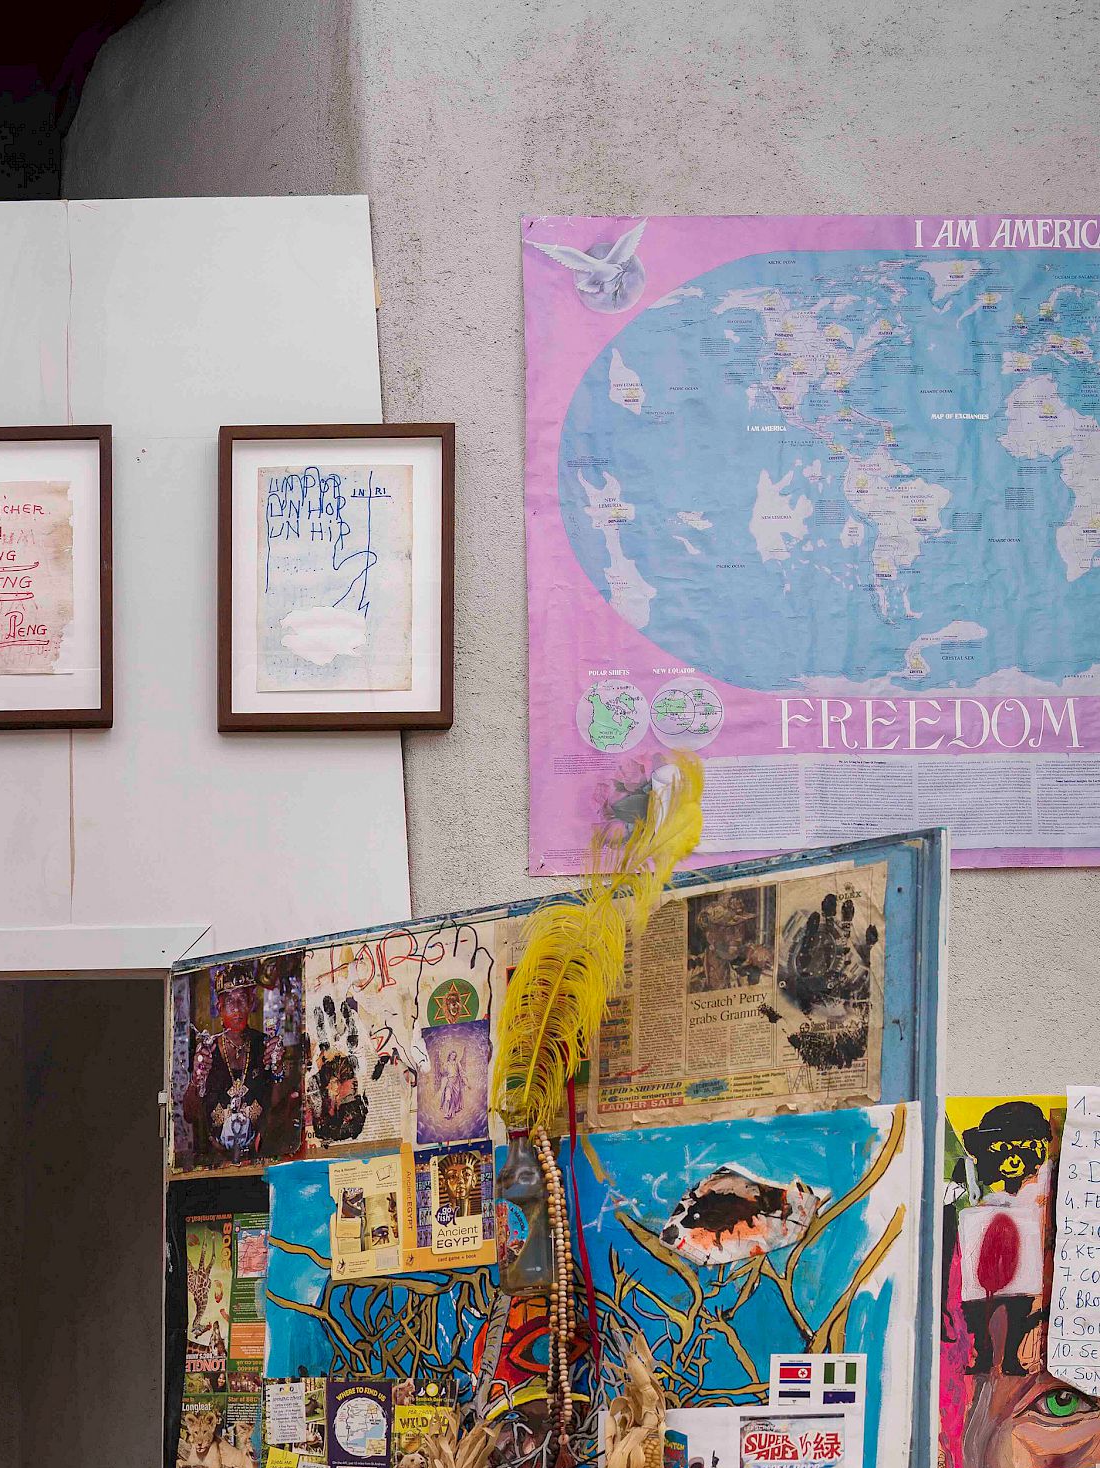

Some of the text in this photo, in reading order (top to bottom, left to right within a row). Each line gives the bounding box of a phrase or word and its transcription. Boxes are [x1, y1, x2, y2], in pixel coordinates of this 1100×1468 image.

[914, 219, 1100, 249] I AM AMERIC
[776, 697, 1085, 752] FREEDOM
[739, 991, 767, 1005] Perry
[689, 1012, 717, 1028] grabs
[601, 1097, 680, 1110] LADDER SALE
[436, 1212, 450, 1223] fish
[441, 1206, 452, 1218] go
[437, 1225, 479, 1237] Ancient
[436, 1235, 479, 1250] EGYPT
[336, 1388, 355, 1402] WHERE
[364, 1387, 378, 1397] FIND
[377, 1393, 386, 1402] US
[181, 1402, 212, 1413] Longleat
[401, 1416, 429, 1429] WILD
[745, 1433, 789, 1454] SUPER
[755, 1444, 799, 1460] APE
